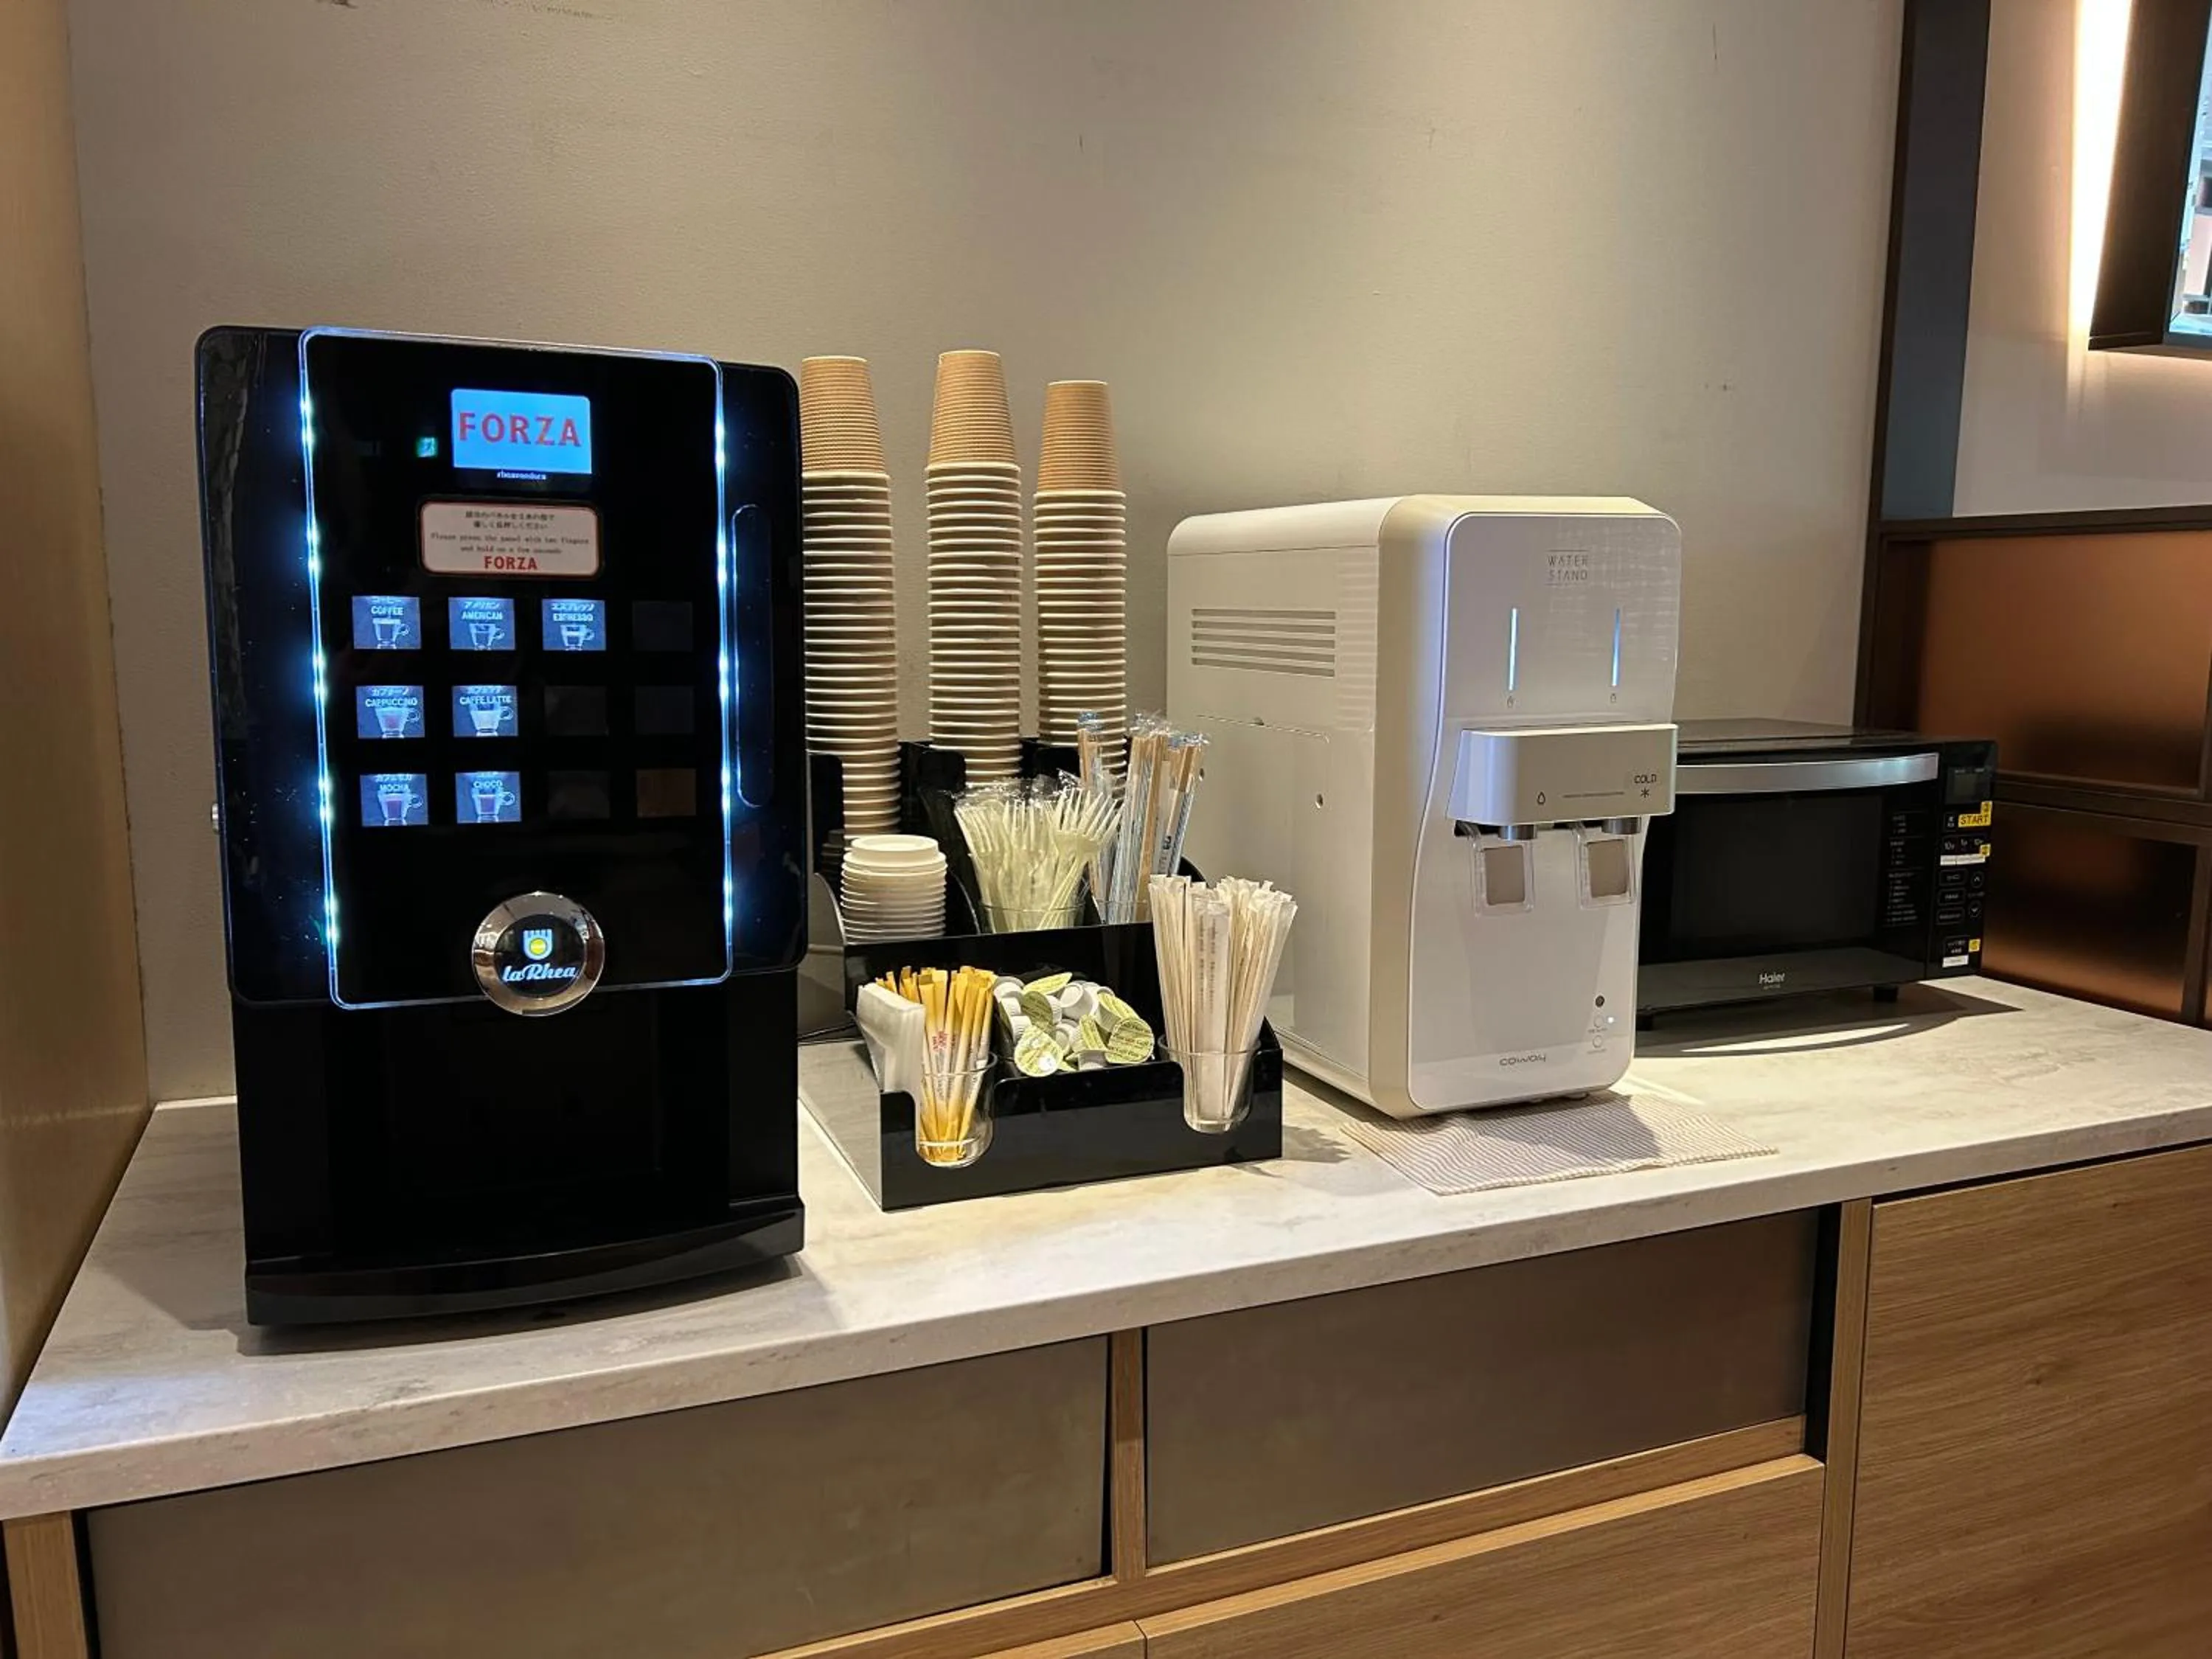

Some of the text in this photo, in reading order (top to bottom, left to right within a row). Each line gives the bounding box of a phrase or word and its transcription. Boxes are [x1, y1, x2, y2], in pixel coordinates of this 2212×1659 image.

[459, 411, 582, 447] FORZA
[484, 555, 538, 571] FORZA
[1548, 554, 1589, 567] WATER
[1549, 569, 1587, 581] STAND
[371, 605, 403, 616] COFFEE
[462, 611, 504, 620] AMERICAN
[1634, 774, 1657, 784] COLD
[379, 784, 410, 792] MOCHA
[1961, 815, 1989, 825] START
[1759, 972, 1785, 984] Haier
